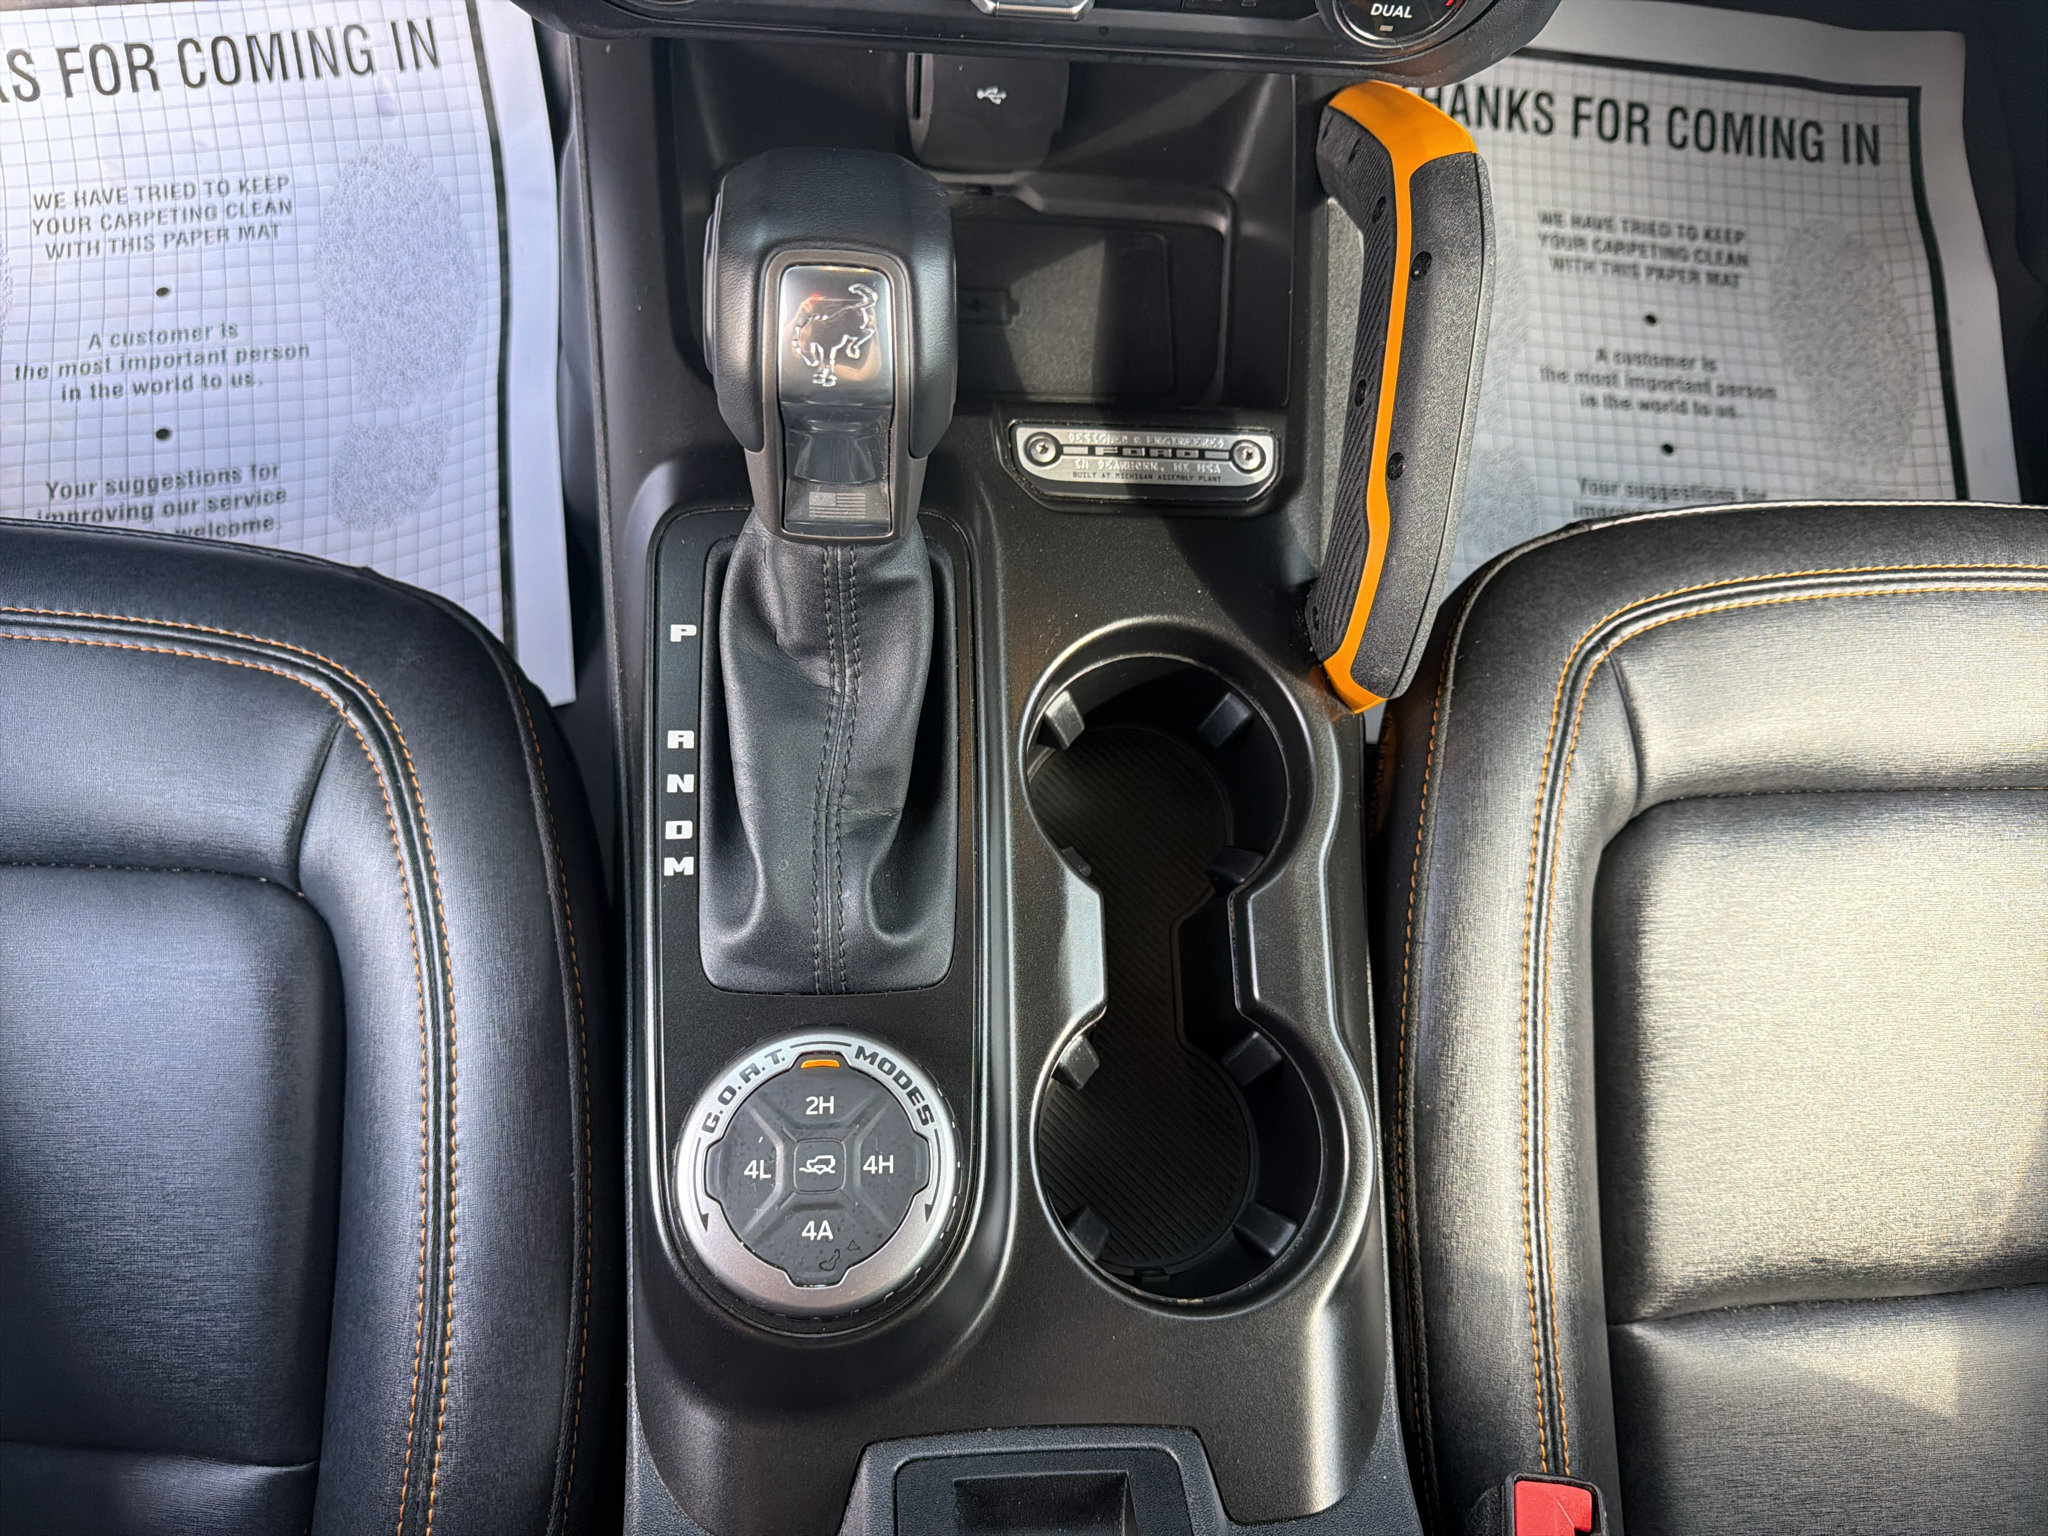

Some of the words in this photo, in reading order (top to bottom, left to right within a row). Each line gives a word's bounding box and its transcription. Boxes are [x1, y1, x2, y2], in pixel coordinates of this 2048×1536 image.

[1370, 3, 1413, 18] DUAL
[0, 49, 41, 102] S
[57, 42, 161, 99] FOR
[177, 24, 376, 89] COMING
[391, 18, 443, 72] IN
[1572, 95, 1650, 145] FOR
[1667, 105, 1824, 164] COMING
[1842, 122, 1882, 167] IN
[33, 191, 66, 210] WE
[74, 186, 128, 208] HAVE
[134, 182, 196, 203] TRIED
[204, 179, 230, 198] TO
[239, 175, 289, 196] KEEP
[32, 216, 92, 236] YOUR
[100, 205, 217, 232] CARPETING
[226, 200, 293, 220] CLEAN
[45, 239, 99, 260] WITH
[108, 234, 155, 255] THIS
[163, 227, 229, 249] PAPER
[238, 223, 280, 241] MAT
[88, 333, 103, 350] A
[110, 325, 213, 349] customer
[220, 320, 239, 340] is
[15, 363, 49, 382] the
[58, 356, 112, 378] most
[120, 348, 227, 374] important
[235, 343, 310, 365] person
[61, 384, 81, 402] in
[90, 381, 123, 400] the
[133, 374, 193, 397] world
[201, 371, 222, 390] to
[231, 369, 263, 388] us.
[46, 480, 97, 500] Your
[105, 467, 242, 497] suggestions
[250, 462, 280, 481] for
[1072, 471, 1097, 479] BUILT
[1158, 474, 1194, 482] ASSEMBLY
[1198, 475, 1222, 483] PLANT
[162, 499, 199, 518] our
[207, 487, 287, 512] service
[670, 624, 697, 642] P
[667, 730, 694, 749] R
[667, 774, 694, 793] N
[665, 820, 693, 839] D
[664, 856, 694, 876] M
[702, 1049, 785, 1133] G.O.A.T.
[855, 1045, 935, 1126] MODES
[805, 1096, 834, 1115] 2H
[744, 1160, 771, 1179] 4L
[863, 1155, 894, 1174] 4H
[802, 1220, 833, 1240] 4A
